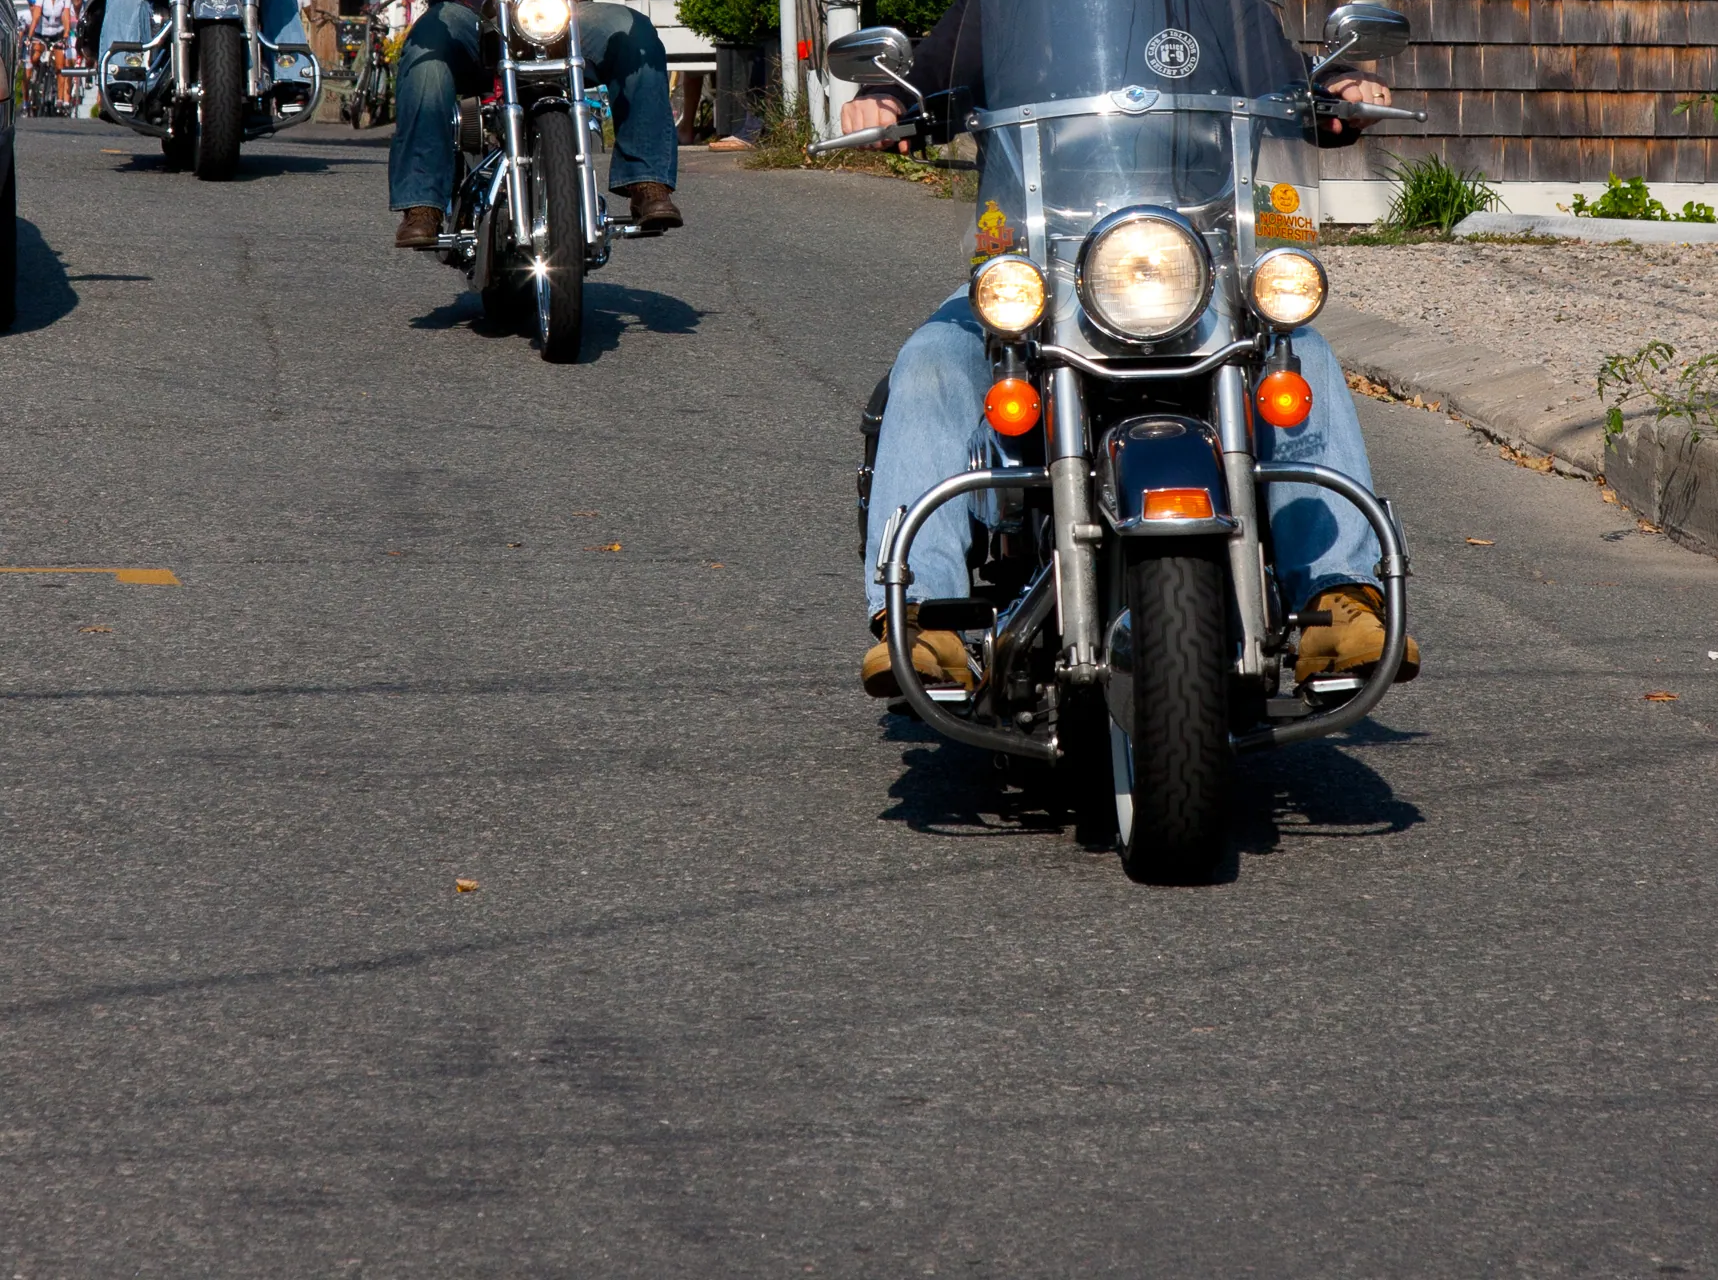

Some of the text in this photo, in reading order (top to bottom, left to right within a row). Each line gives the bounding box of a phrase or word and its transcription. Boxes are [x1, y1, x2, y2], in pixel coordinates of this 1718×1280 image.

[1148, 37, 1161, 56] CAPE
[1169, 30, 1197, 54] ISLANDS
[1160, 43, 1185, 52] POLICE
[1149, 56, 1197, 76] RELIEF FUND
[1161, 50, 1185, 63] K-9
[1259, 210, 1313, 230] NORWICH
[1255, 223, 1319, 242] UNIVERSITY
